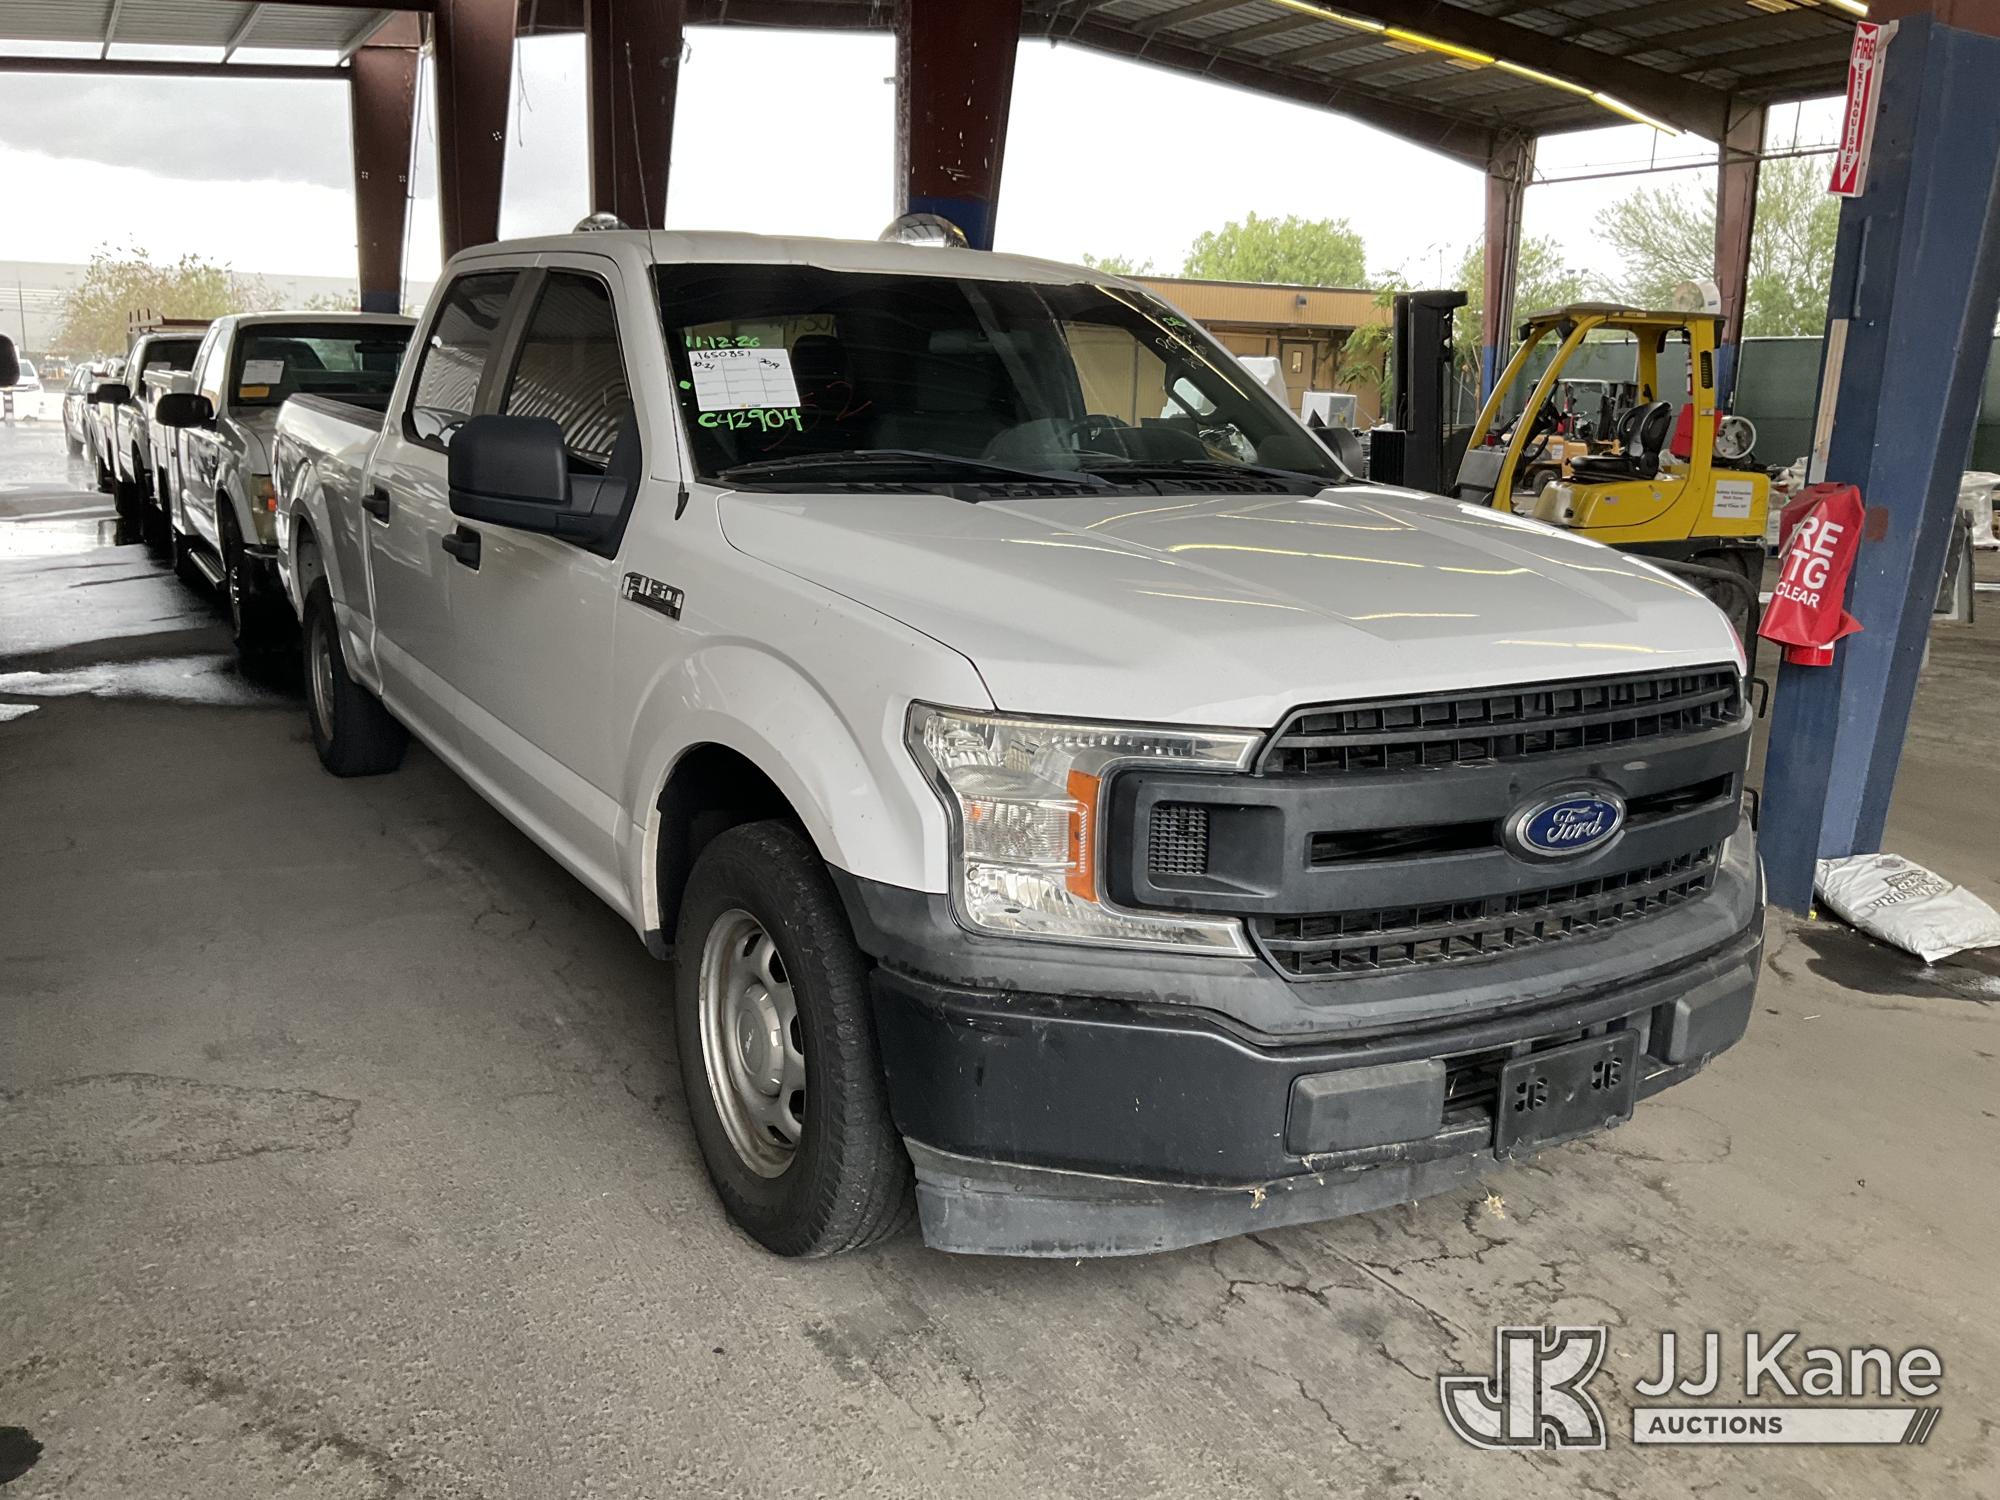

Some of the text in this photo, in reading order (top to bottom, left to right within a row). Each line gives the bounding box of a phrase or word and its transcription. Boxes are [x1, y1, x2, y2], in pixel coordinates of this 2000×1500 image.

[1854, 37, 1876, 61] FIRE
[1842, 62, 1865, 173] EXTINGUISHER
[698, 408, 803, 431] C42904
[1775, 581, 1820, 608] CLEAR
[1546, 806, 1605, 843] Ford
